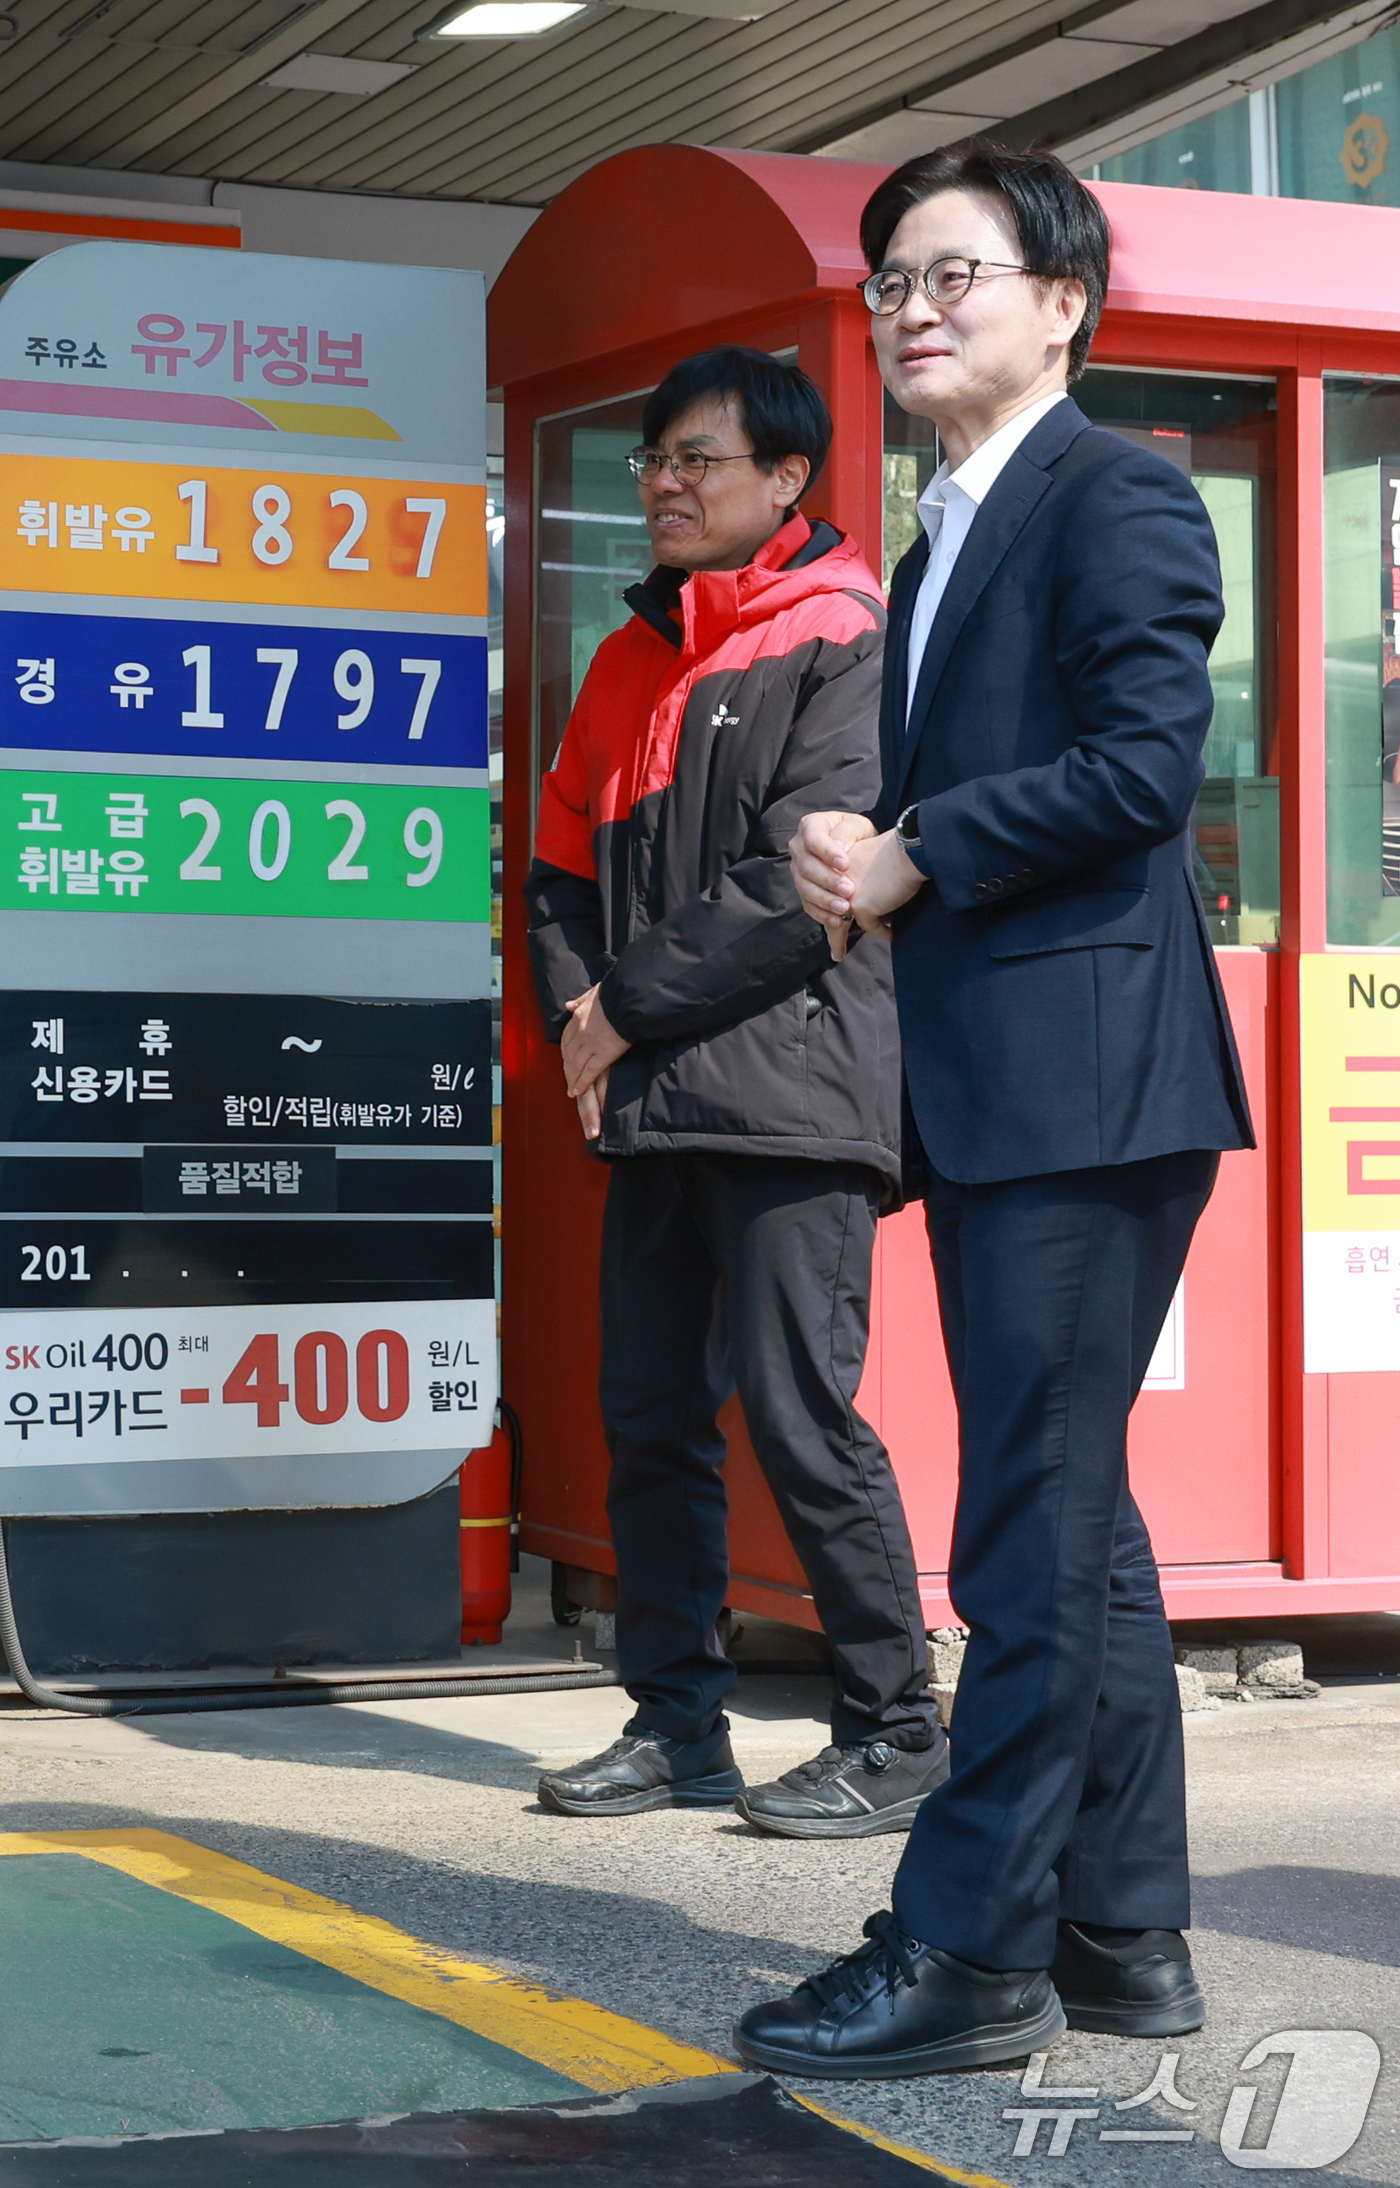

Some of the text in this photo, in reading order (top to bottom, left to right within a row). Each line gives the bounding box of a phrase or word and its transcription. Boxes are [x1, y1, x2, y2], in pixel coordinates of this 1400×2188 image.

[25, 313, 369, 388] 주유소 유가정보
[16, 499, 155, 554] 휘발유
[17, 846, 149, 897] 휘발유
[1349, 973, 1400, 1009] No
[31, 1066, 174, 1104] 신용카드
[420, 1103, 463, 1128] 기준)
[178, 1160, 303, 1195] 품질적합
[1346, 1245, 1389, 1273] 흡연
[177, 1335, 209, 1353] 최대
[427, 1339, 480, 1368] 원/L
[428, 1380, 479, 1413] 할인
[4, 1389, 168, 1440] 우리카드
